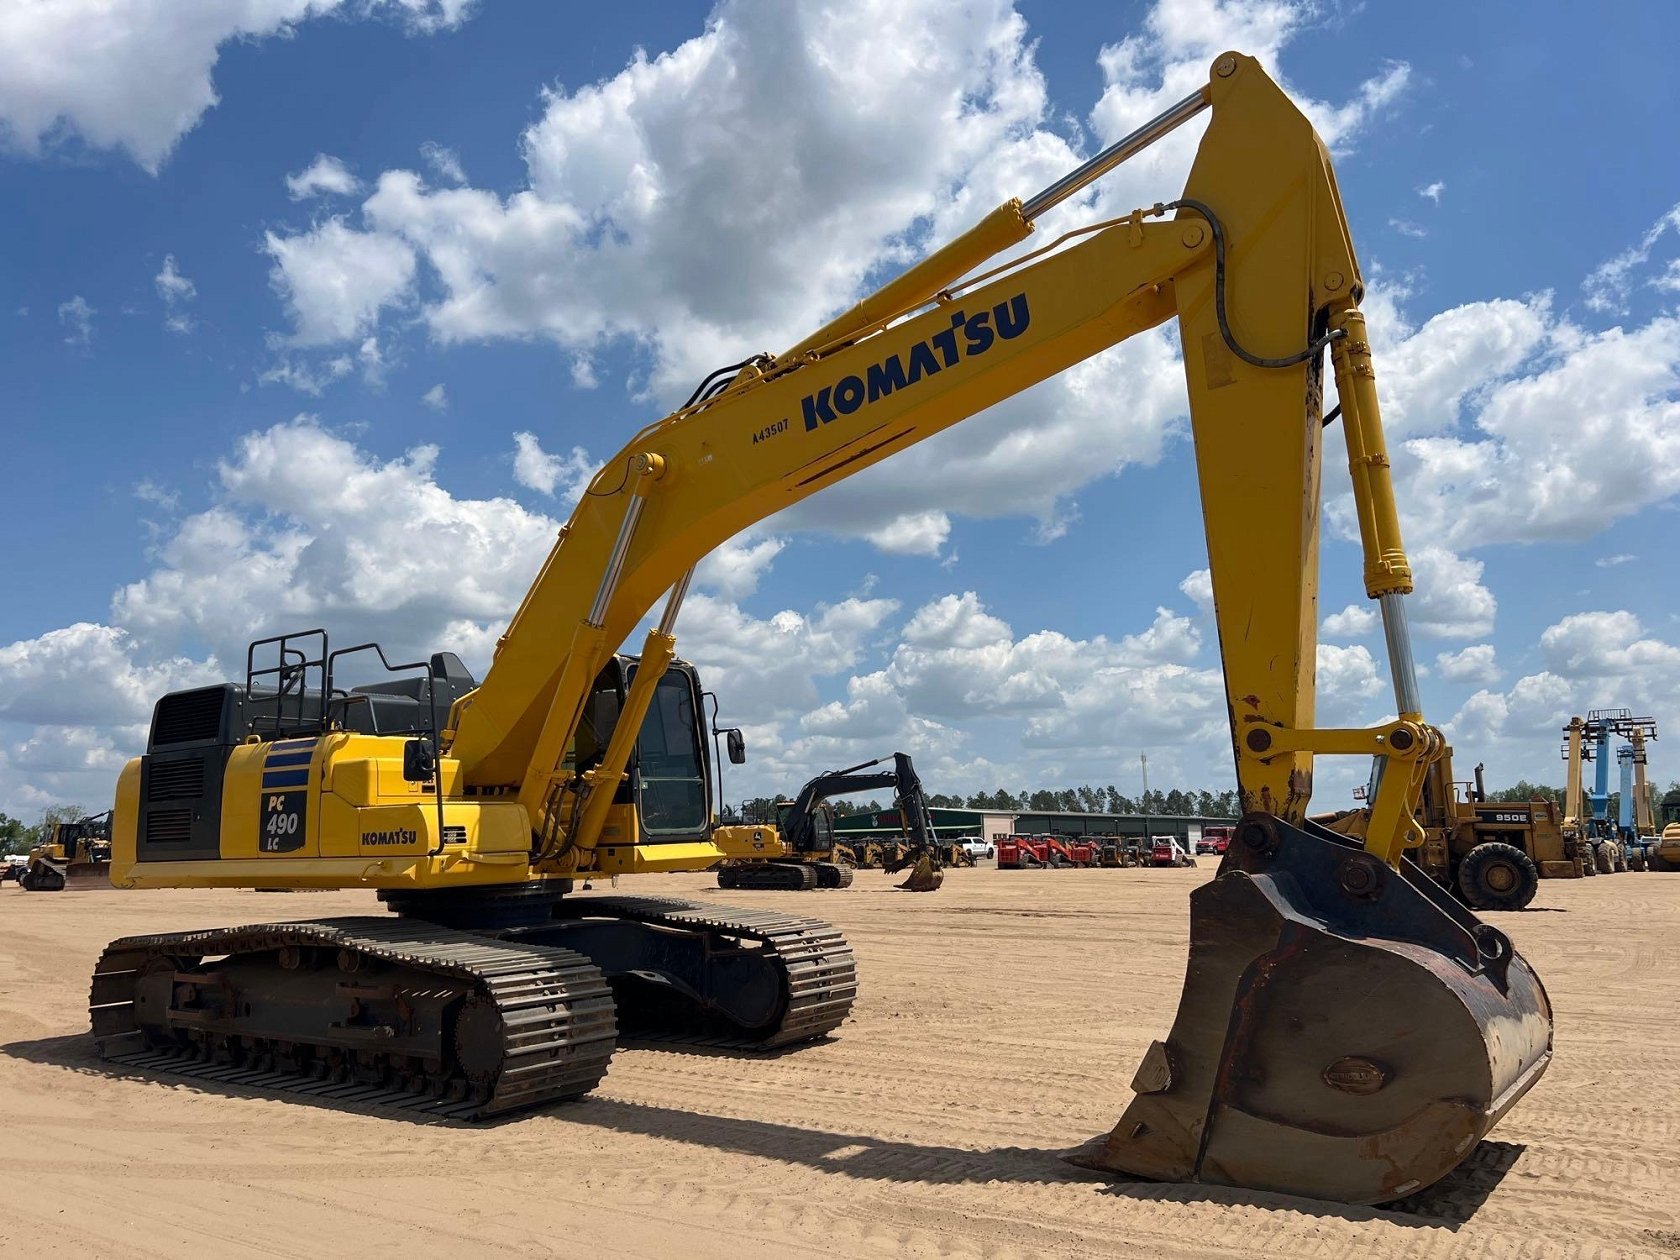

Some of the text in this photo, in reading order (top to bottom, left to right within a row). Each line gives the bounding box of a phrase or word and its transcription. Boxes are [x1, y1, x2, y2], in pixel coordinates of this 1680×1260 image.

[801, 293, 1030, 432] KOMATSU
[753, 418, 788, 445] A43507
[268, 795, 285, 812] PC
[267, 812, 298, 835] 490
[267, 837, 280, 850] LC
[361, 827, 417, 846] KOMATSU
